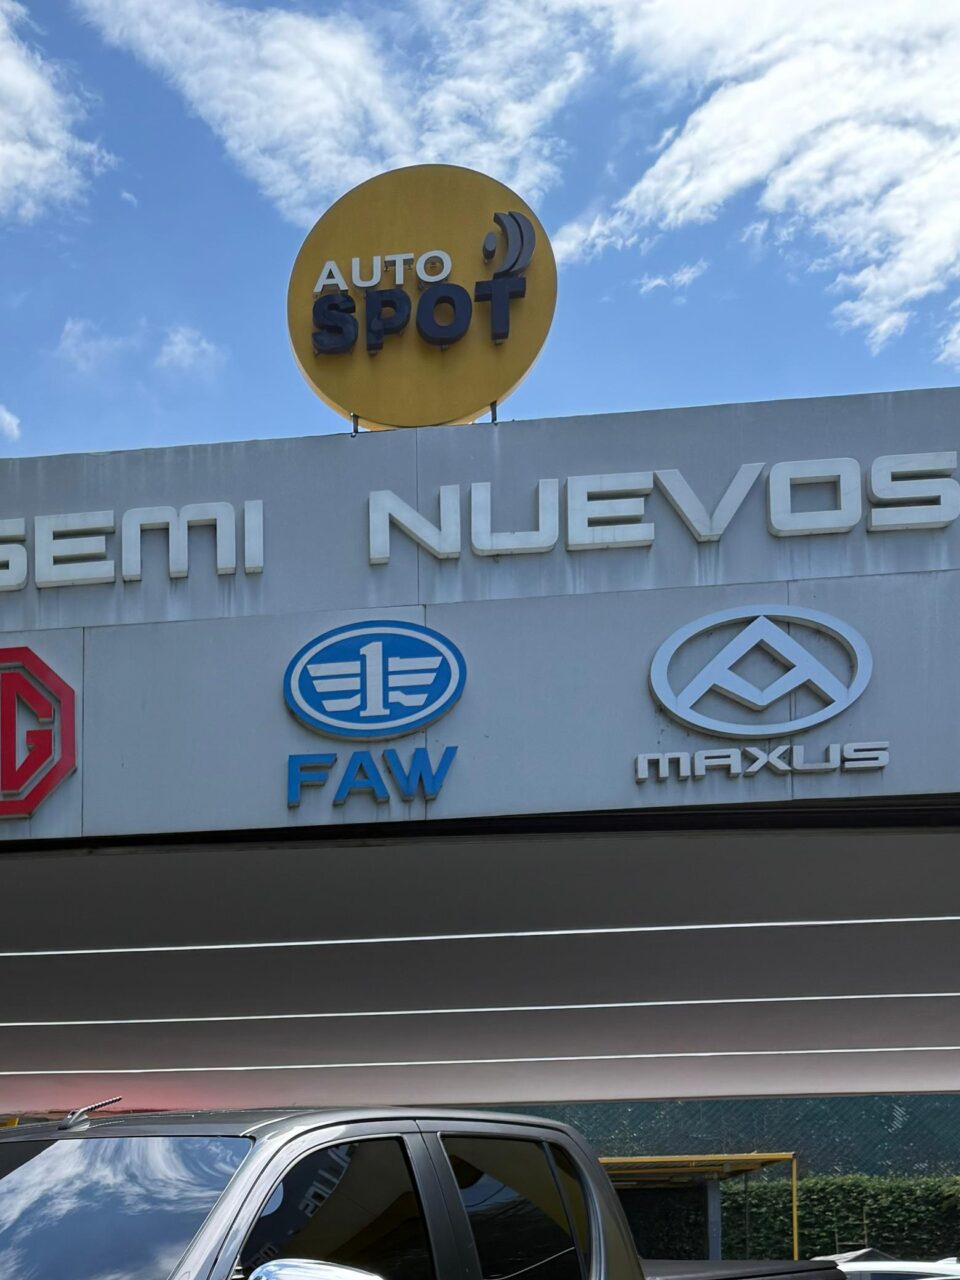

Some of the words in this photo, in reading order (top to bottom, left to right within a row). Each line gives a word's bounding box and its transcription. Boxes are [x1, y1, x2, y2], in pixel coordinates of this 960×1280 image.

[313, 250, 452, 293] AUTO
[312, 276, 526, 356] SPOT
[369, 451, 960, 565] NUEVOS
[287, 745, 459, 808] FAW
[635, 741, 890, 784] MAXUS
